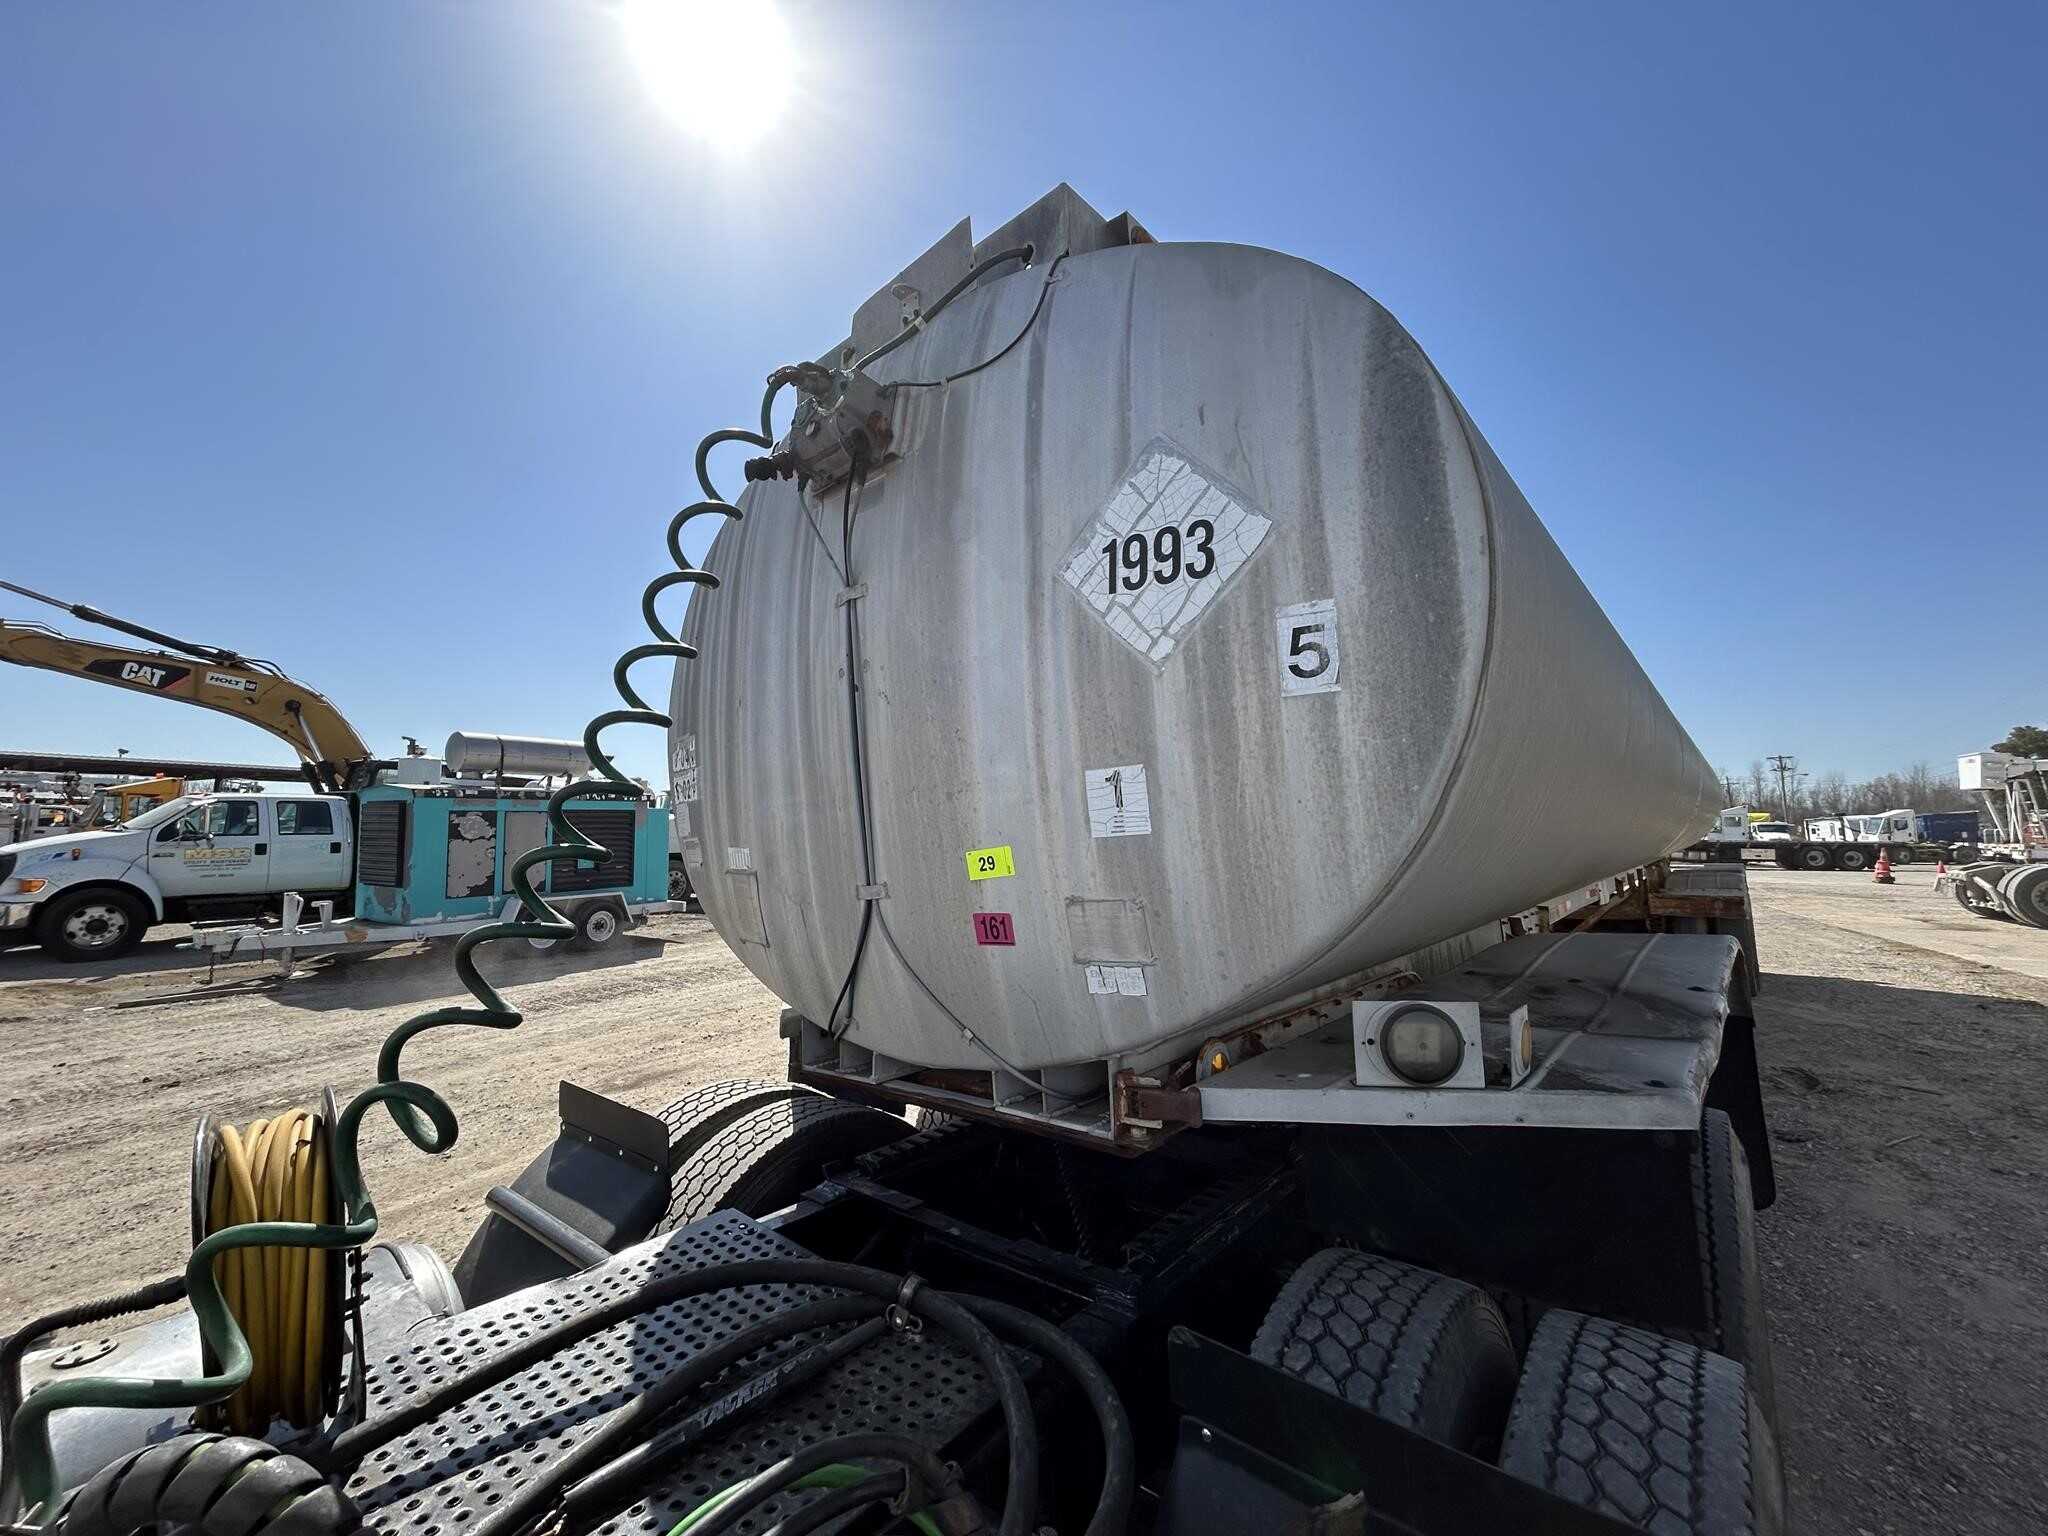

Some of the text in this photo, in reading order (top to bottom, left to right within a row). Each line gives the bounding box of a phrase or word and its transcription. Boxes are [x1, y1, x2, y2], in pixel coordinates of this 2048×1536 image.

[1102, 519, 1216, 595] 1993
[1288, 623, 1331, 679] 5
[121, 662, 166, 688] CAT
[208, 673, 242, 687] HOLT
[1104, 769, 1124, 809] 1
[978, 855, 996, 872] 29
[981, 915, 1008, 940] 161
